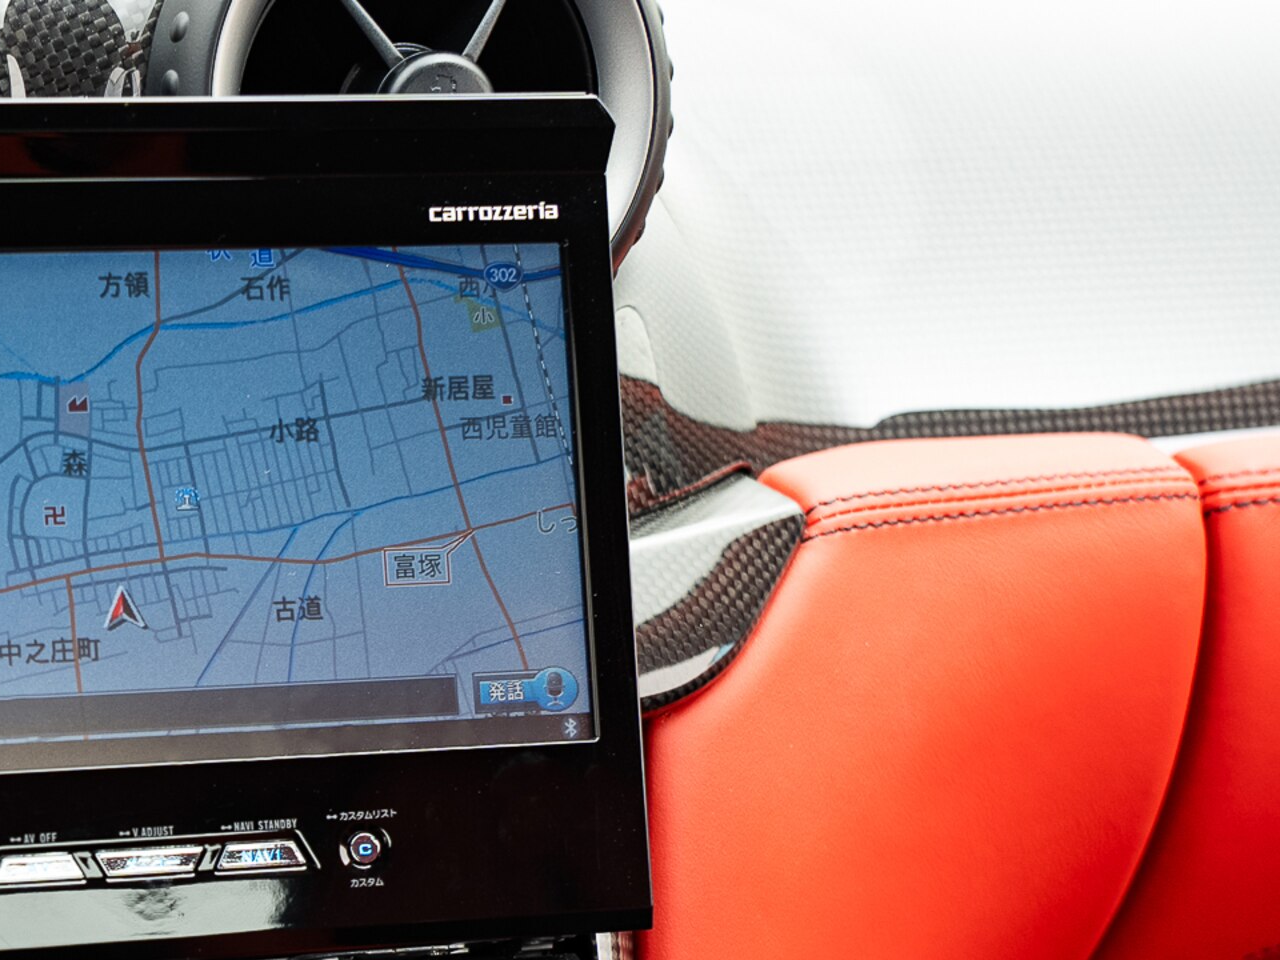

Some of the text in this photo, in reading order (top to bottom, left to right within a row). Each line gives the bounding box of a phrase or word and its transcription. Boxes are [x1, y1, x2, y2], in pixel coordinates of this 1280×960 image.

[429, 202, 559, 222] carrozzeria
[98, 271, 150, 298] 方領
[489, 267, 518, 283] 302
[240, 275, 291, 301] 石作
[421, 374, 495, 401] 新居屋
[270, 417, 320, 443] 小路
[460, 414, 559, 441] 西児童館
[62, 450, 88, 476] 森
[393, 553, 442, 580] 富塚
[272, 595, 324, 623] 古道
[488, 680, 525, 703] 発話
[233, 818, 298, 833] NAVI STANDBY
[339, 808, 398, 821] カスタムリスト
[23, 832, 58, 845] AV OFF
[358, 843, 373, 856] C
[350, 877, 385, 889] カスタム
